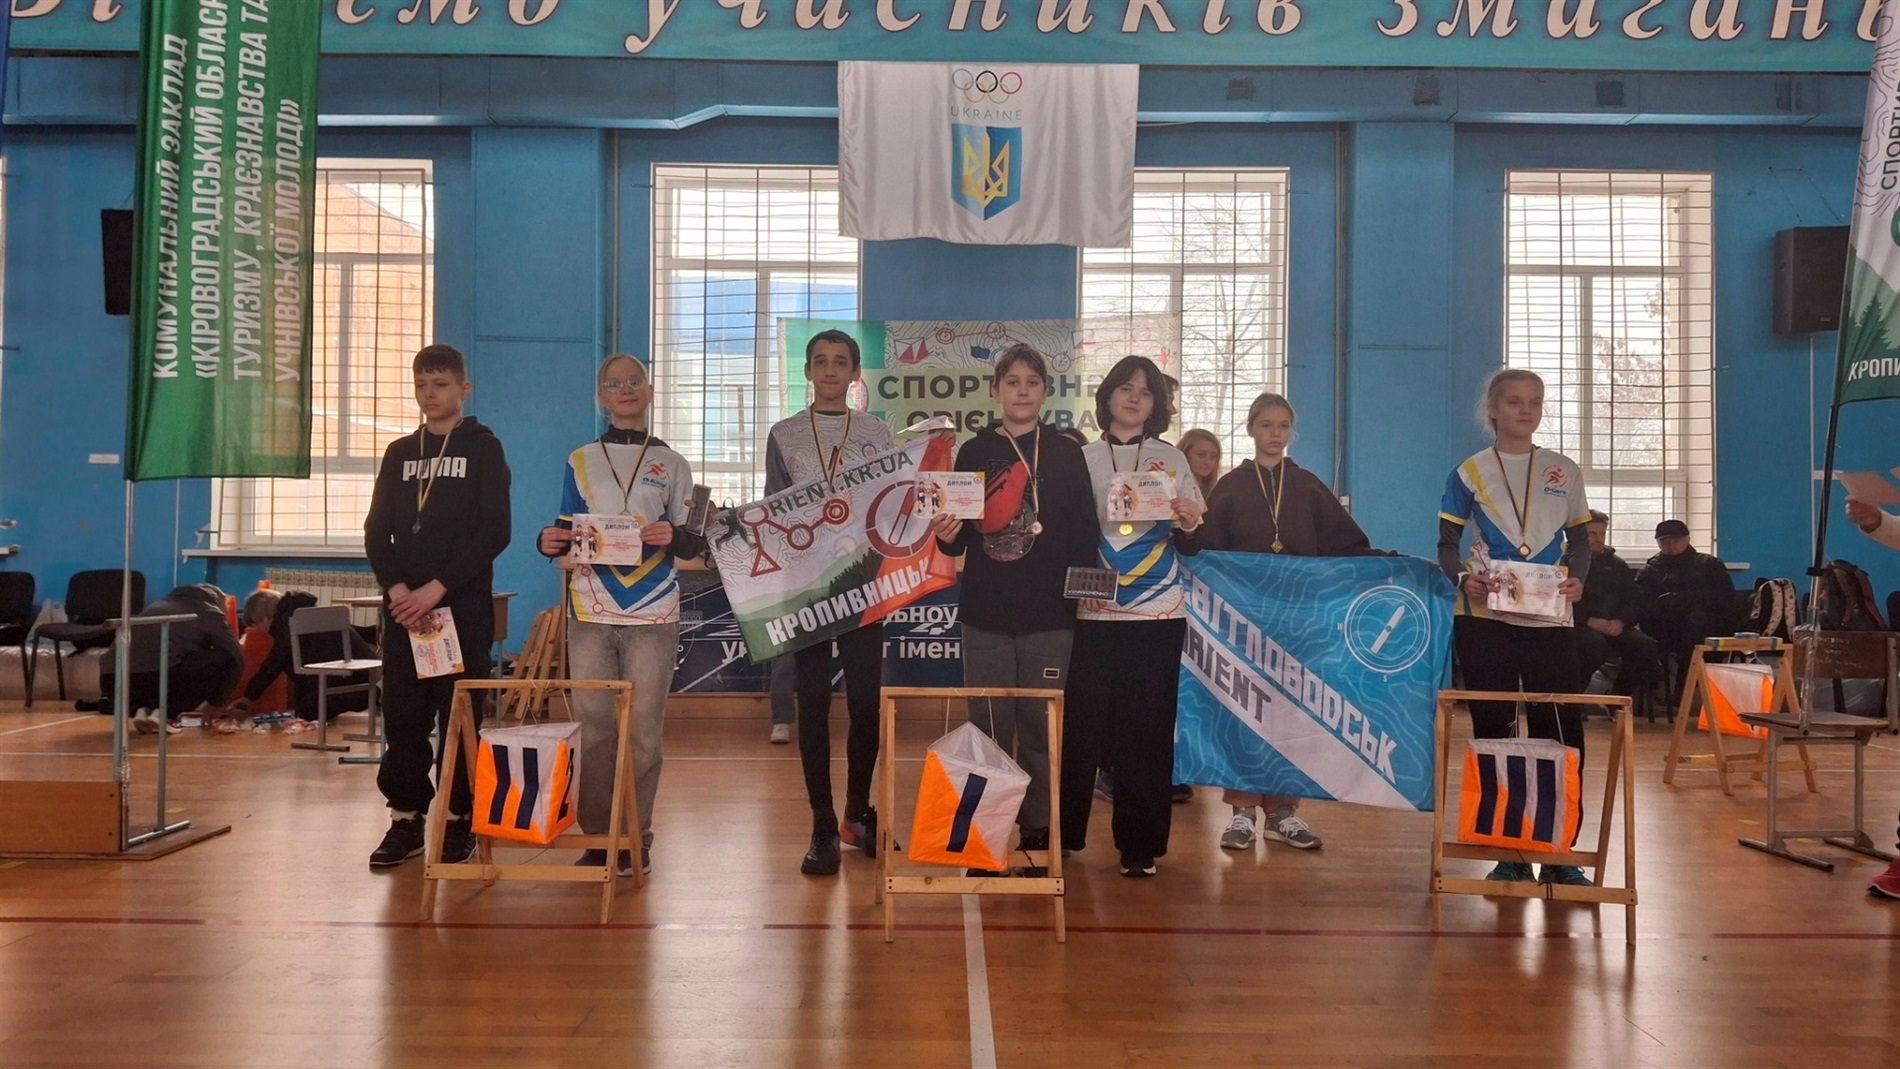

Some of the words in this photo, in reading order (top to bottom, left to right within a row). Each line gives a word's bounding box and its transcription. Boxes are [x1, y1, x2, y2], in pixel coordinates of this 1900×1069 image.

[160, 33, 188, 155] ЗАКЛАД
[234, 32, 268, 236] КРАЄЗНАВСТВА
[950, 105, 1022, 121] UKRAINE
[153, 159, 180, 378] КОМУНАЛЬНИЙ
[270, 223, 300, 382] УЧНІВСЬКОЇ
[402, 456, 467, 481] PUMA
[1182, 620, 1272, 724] RIENT
